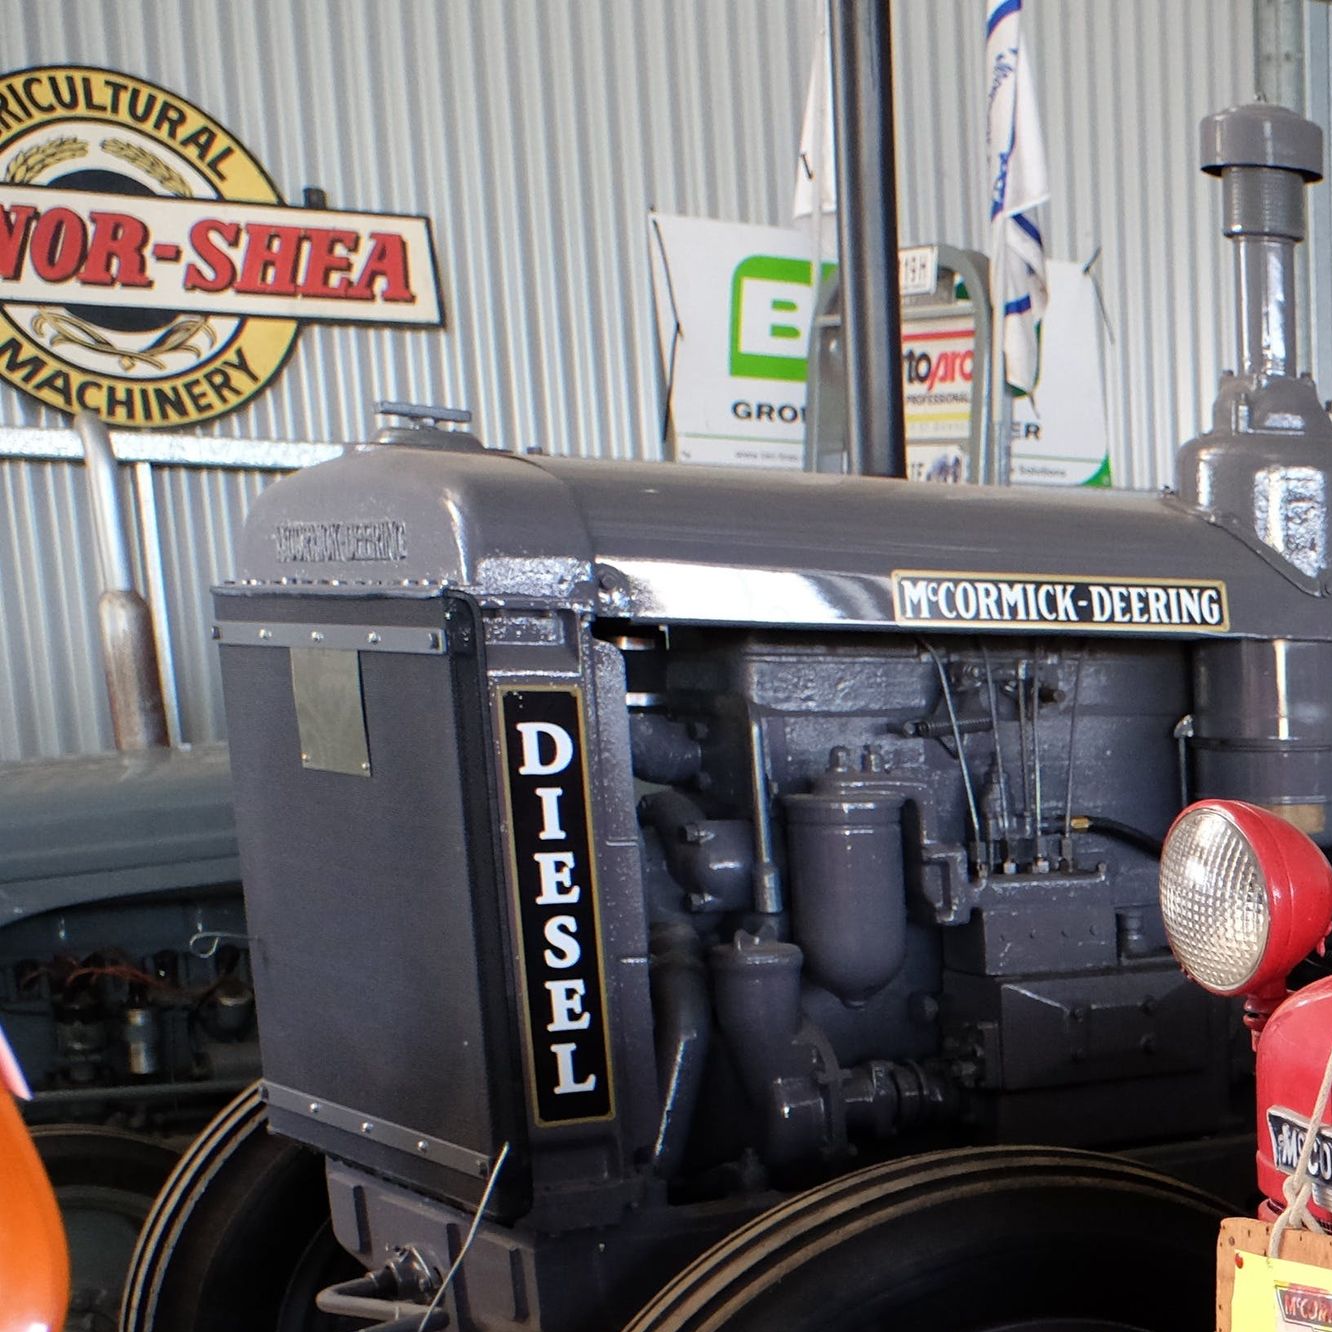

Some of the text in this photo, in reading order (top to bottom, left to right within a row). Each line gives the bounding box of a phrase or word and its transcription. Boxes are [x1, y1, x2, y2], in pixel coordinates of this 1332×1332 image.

[0, 338, 260, 421] MACHINERY
[901, 579, 1222, 625] McCORMICK-DEERING
[516, 722, 596, 1095] DIESEL
